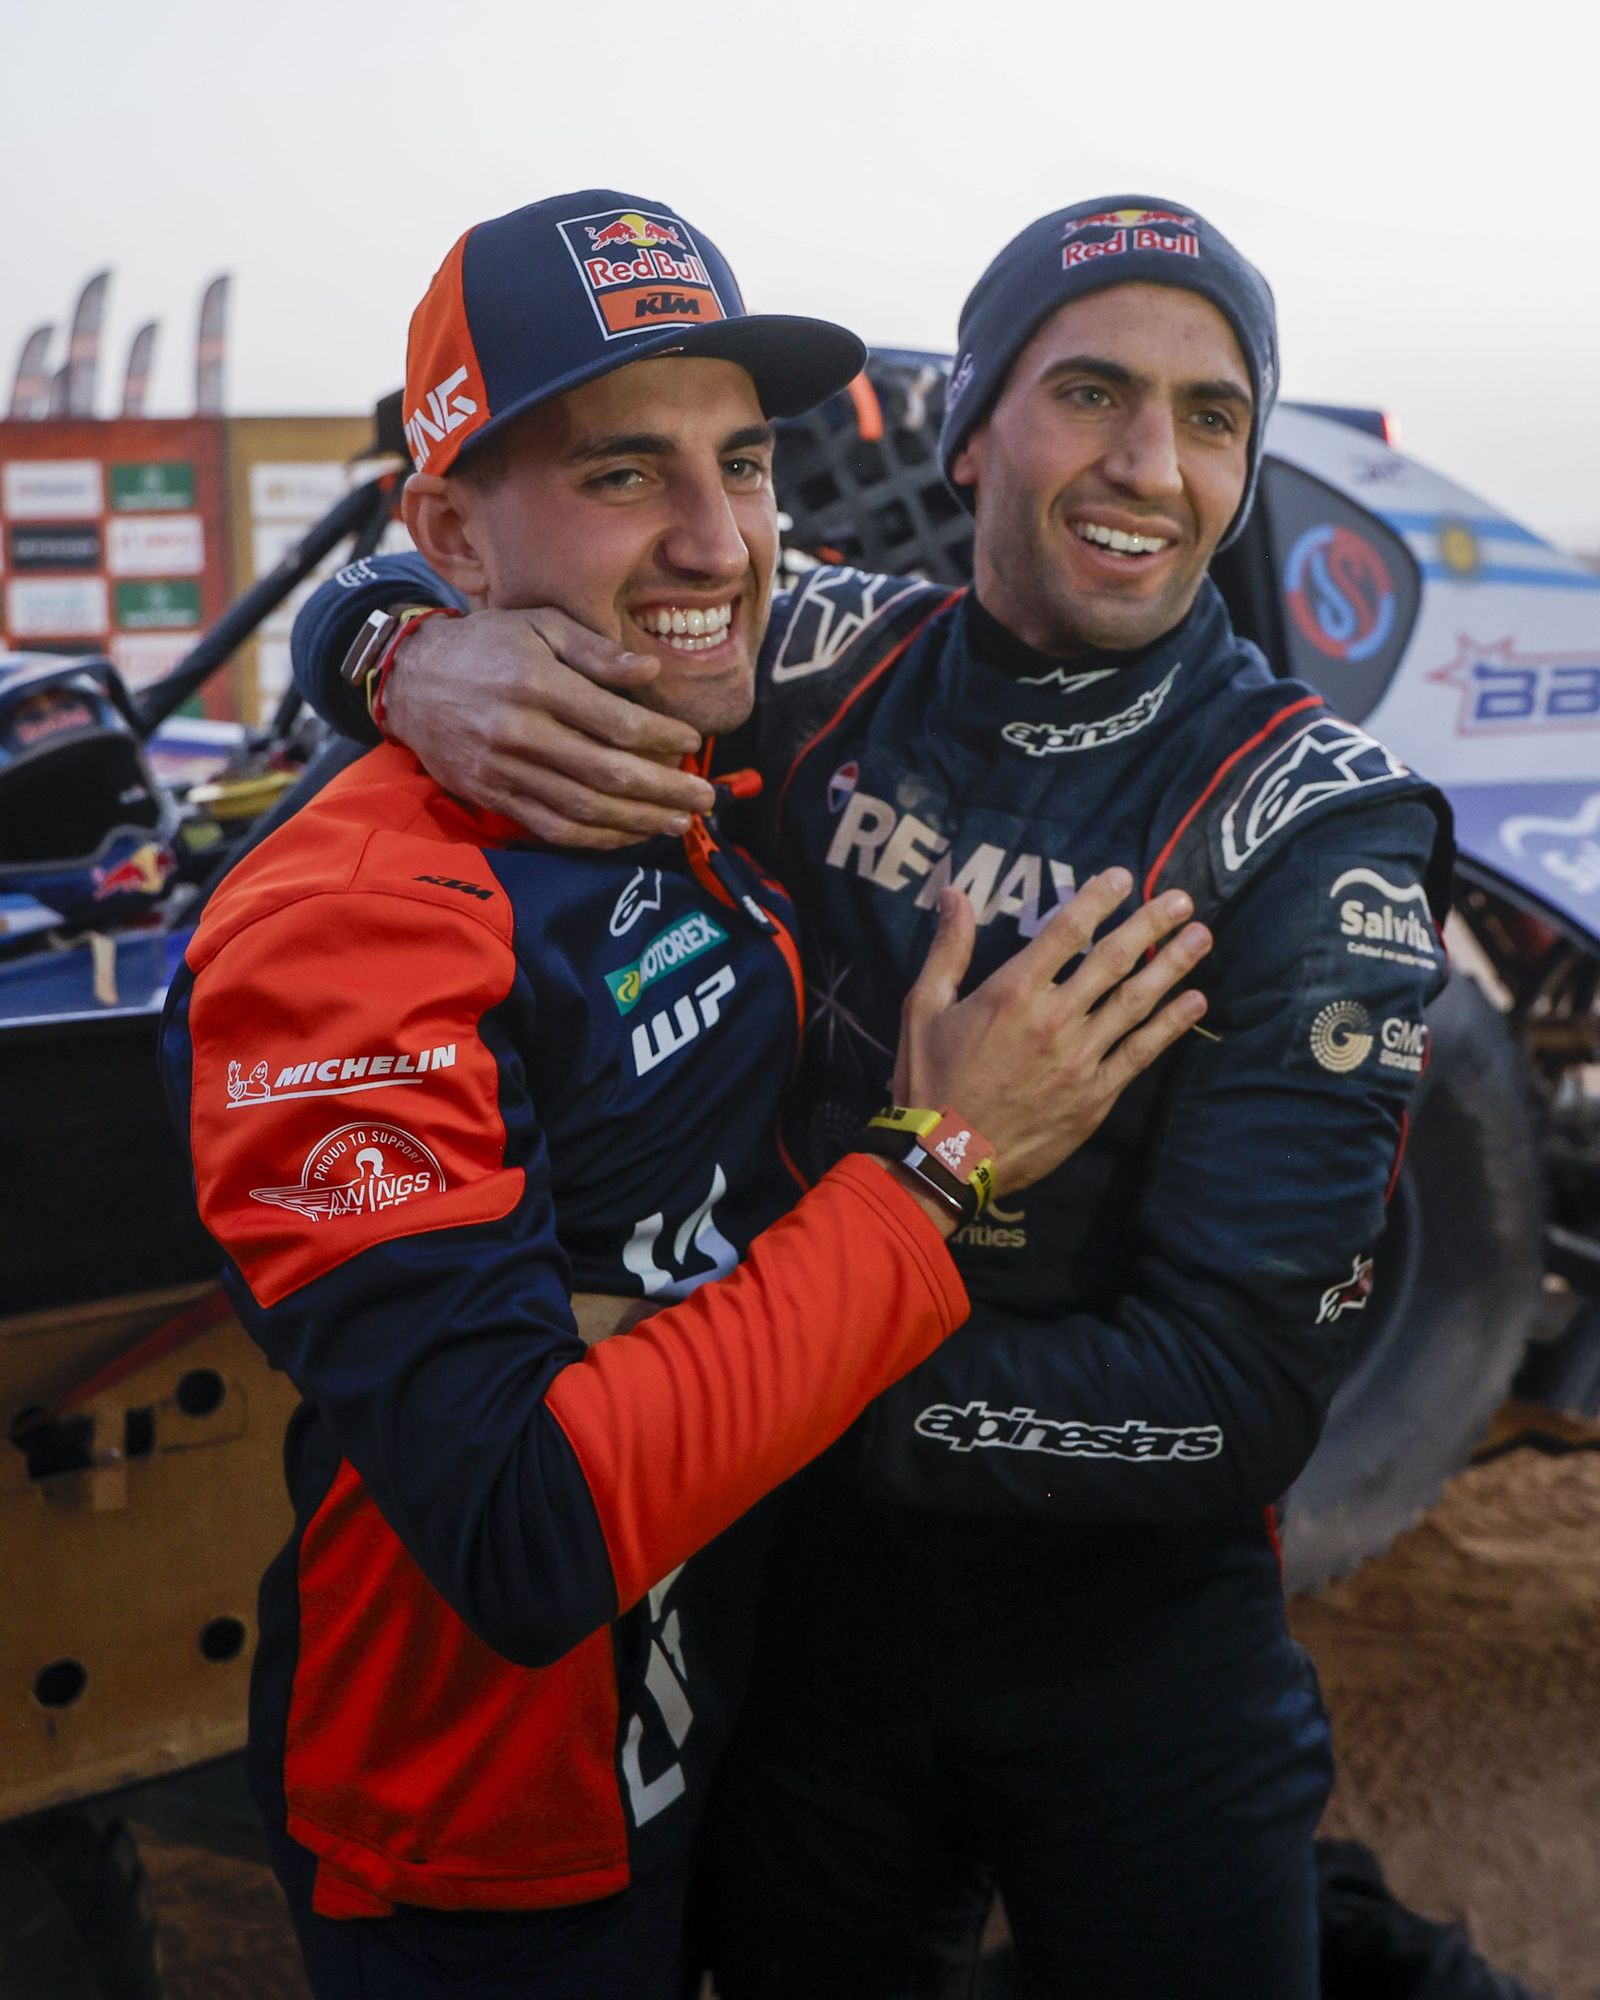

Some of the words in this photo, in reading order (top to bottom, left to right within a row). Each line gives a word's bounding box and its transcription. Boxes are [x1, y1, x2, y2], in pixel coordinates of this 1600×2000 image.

[584, 248, 657, 289] Red
[650, 250, 709, 286] Bull
[1062, 229, 1127, 270] Red
[1133, 229, 1200, 259] Bull
[635, 292, 700, 318] KTM
[638, 912, 721, 985] MOTOREX
[631, 964, 736, 1078] WP
[274, 1044, 457, 1088] MICHELIN
[314, 1140, 348, 1181] PROUD
[348, 1131, 366, 1147] TO
[371, 1131, 424, 1164] SUPPORT
[335, 1171, 432, 1213] WINGS
[914, 1400, 1225, 1462] alpinestars
